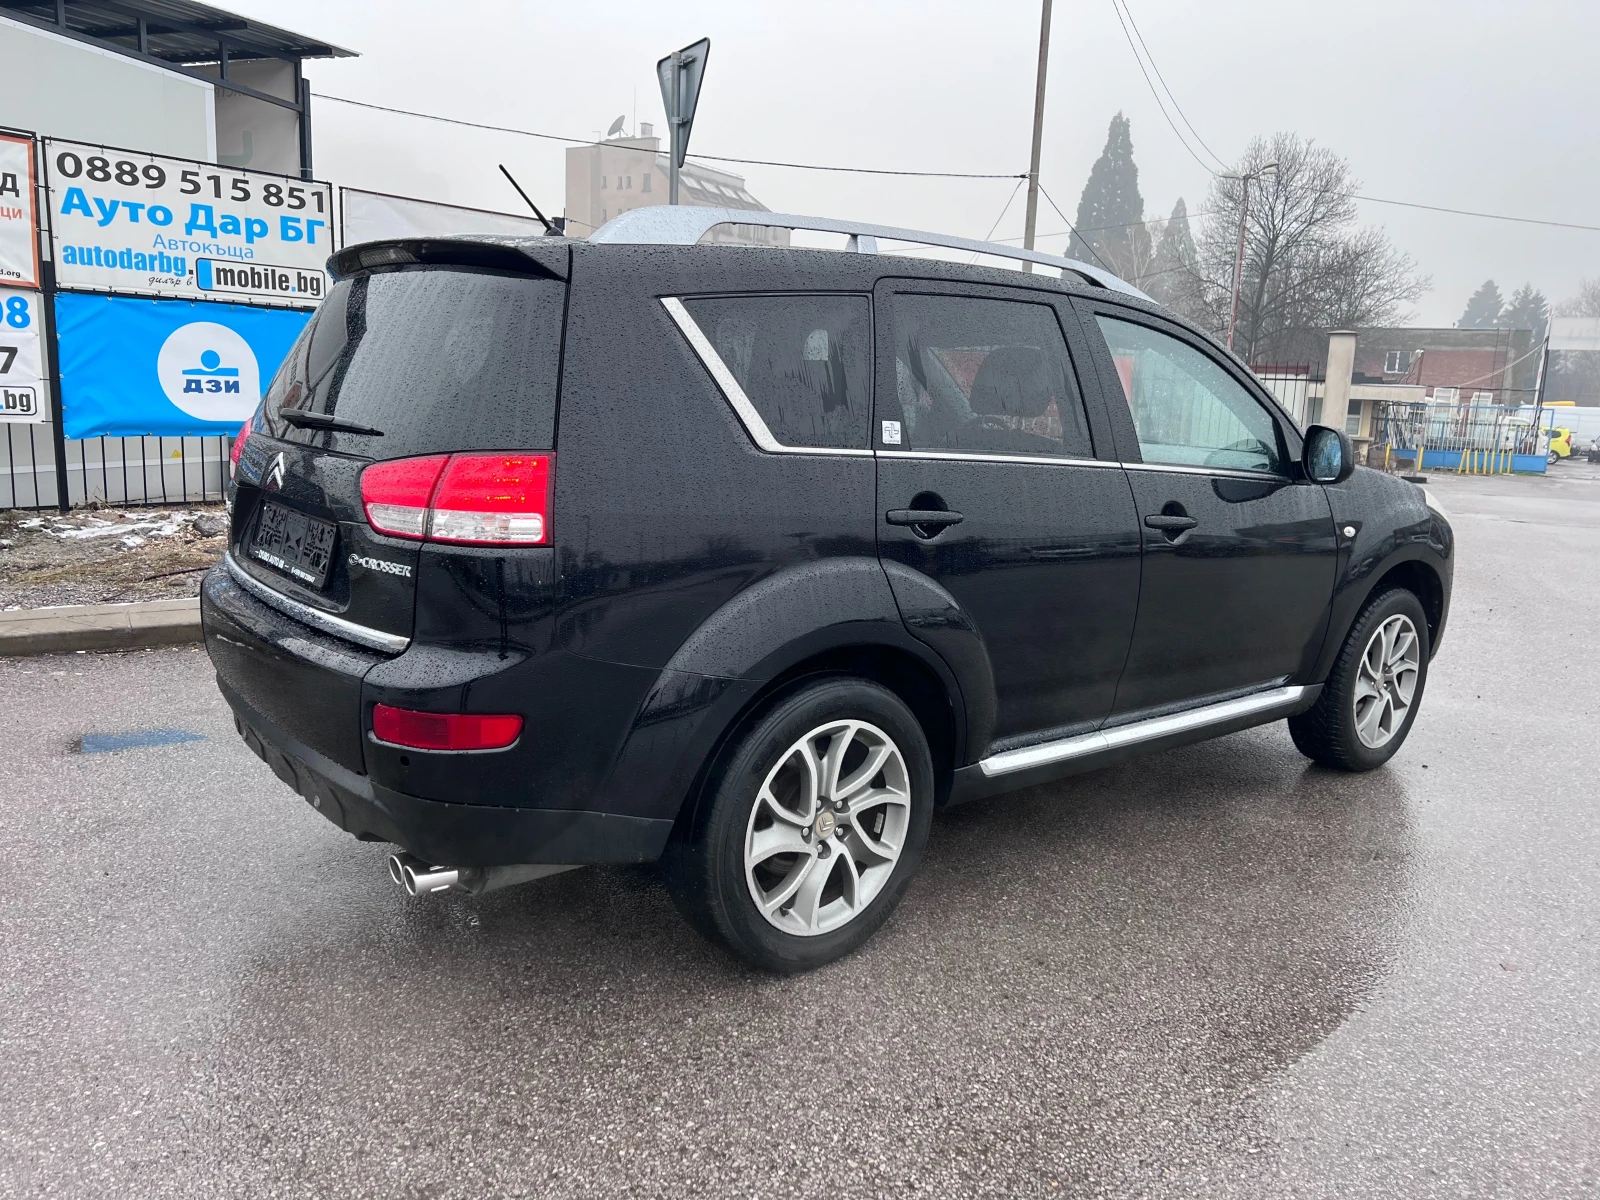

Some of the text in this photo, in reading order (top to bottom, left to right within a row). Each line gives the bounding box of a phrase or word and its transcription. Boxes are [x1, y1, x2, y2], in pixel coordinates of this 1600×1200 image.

[56, 151, 325, 213] 0889 515 851
[60, 186, 325, 245] Ауто Дар БГ
[153, 233, 255, 260] Автокъща
[215, 265, 321, 297] mobile.bg
[183, 379, 240, 394] ДЗИ
